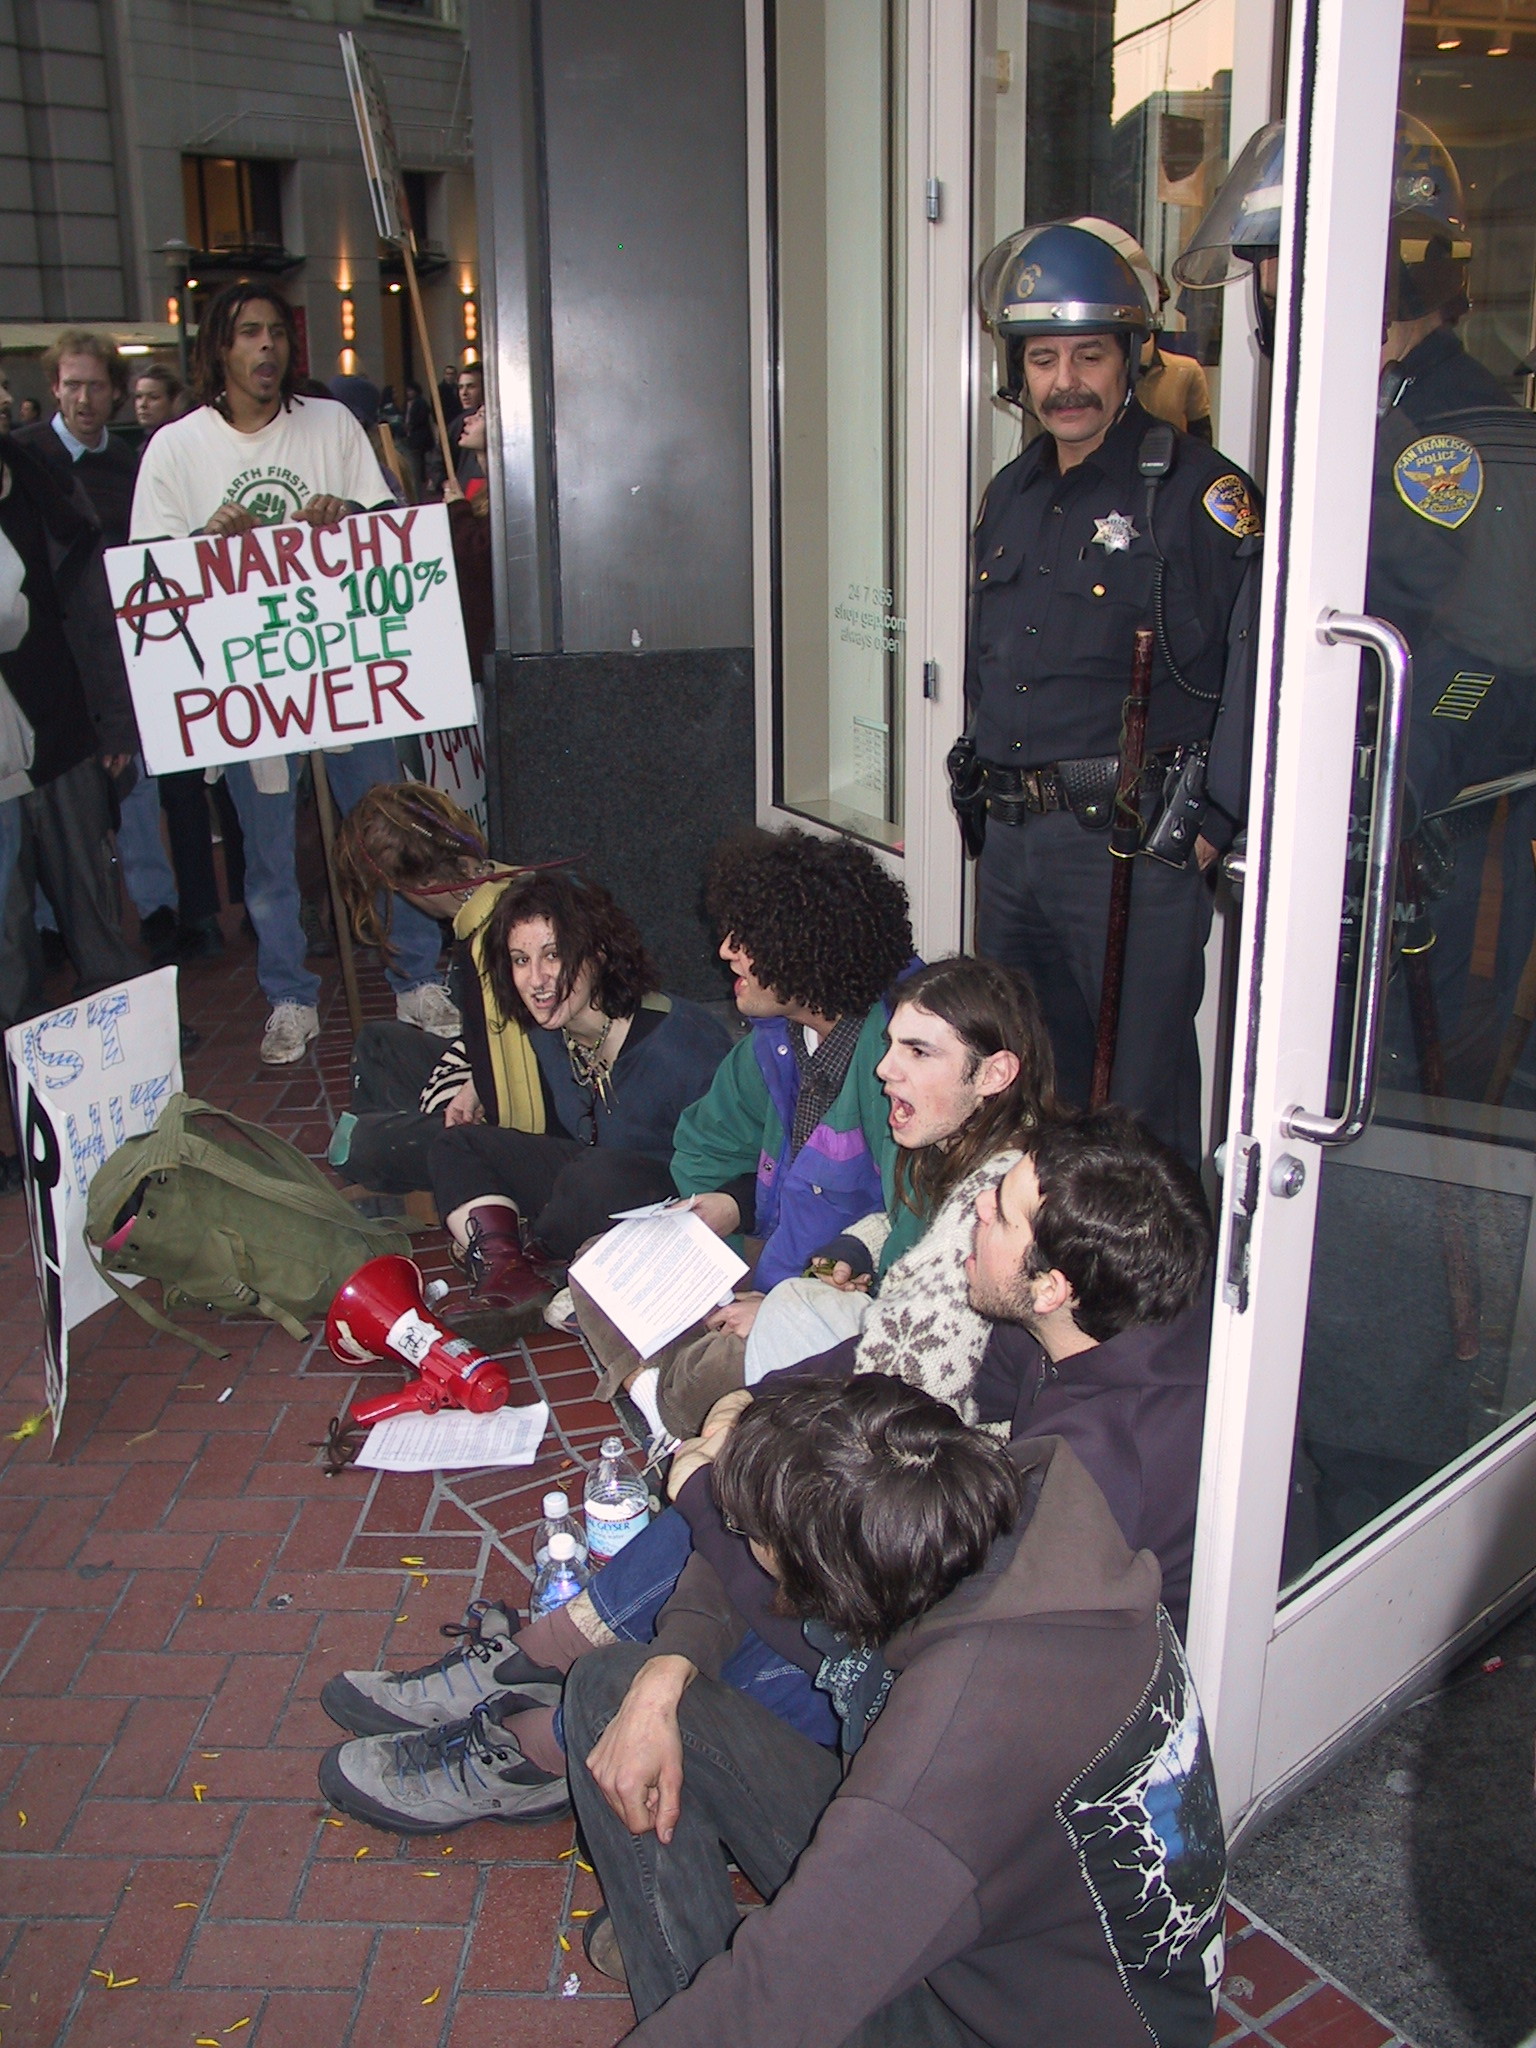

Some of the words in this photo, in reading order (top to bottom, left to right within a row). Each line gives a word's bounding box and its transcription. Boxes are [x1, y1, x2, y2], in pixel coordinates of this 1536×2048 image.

[1399, 450, 1417, 469] SAN
[1416, 438, 1474, 455] FRANCISCO
[1416, 450, 1457, 467] POLICE
[267, 466, 311, 498] FIRST!
[258, 586, 319, 631] IS
[340, 557, 448, 620] 100%
[221, 616, 412, 683] PEOPLE
[173, 660, 425, 757] POWER
[597, 1521, 630, 1531] GEYSER
